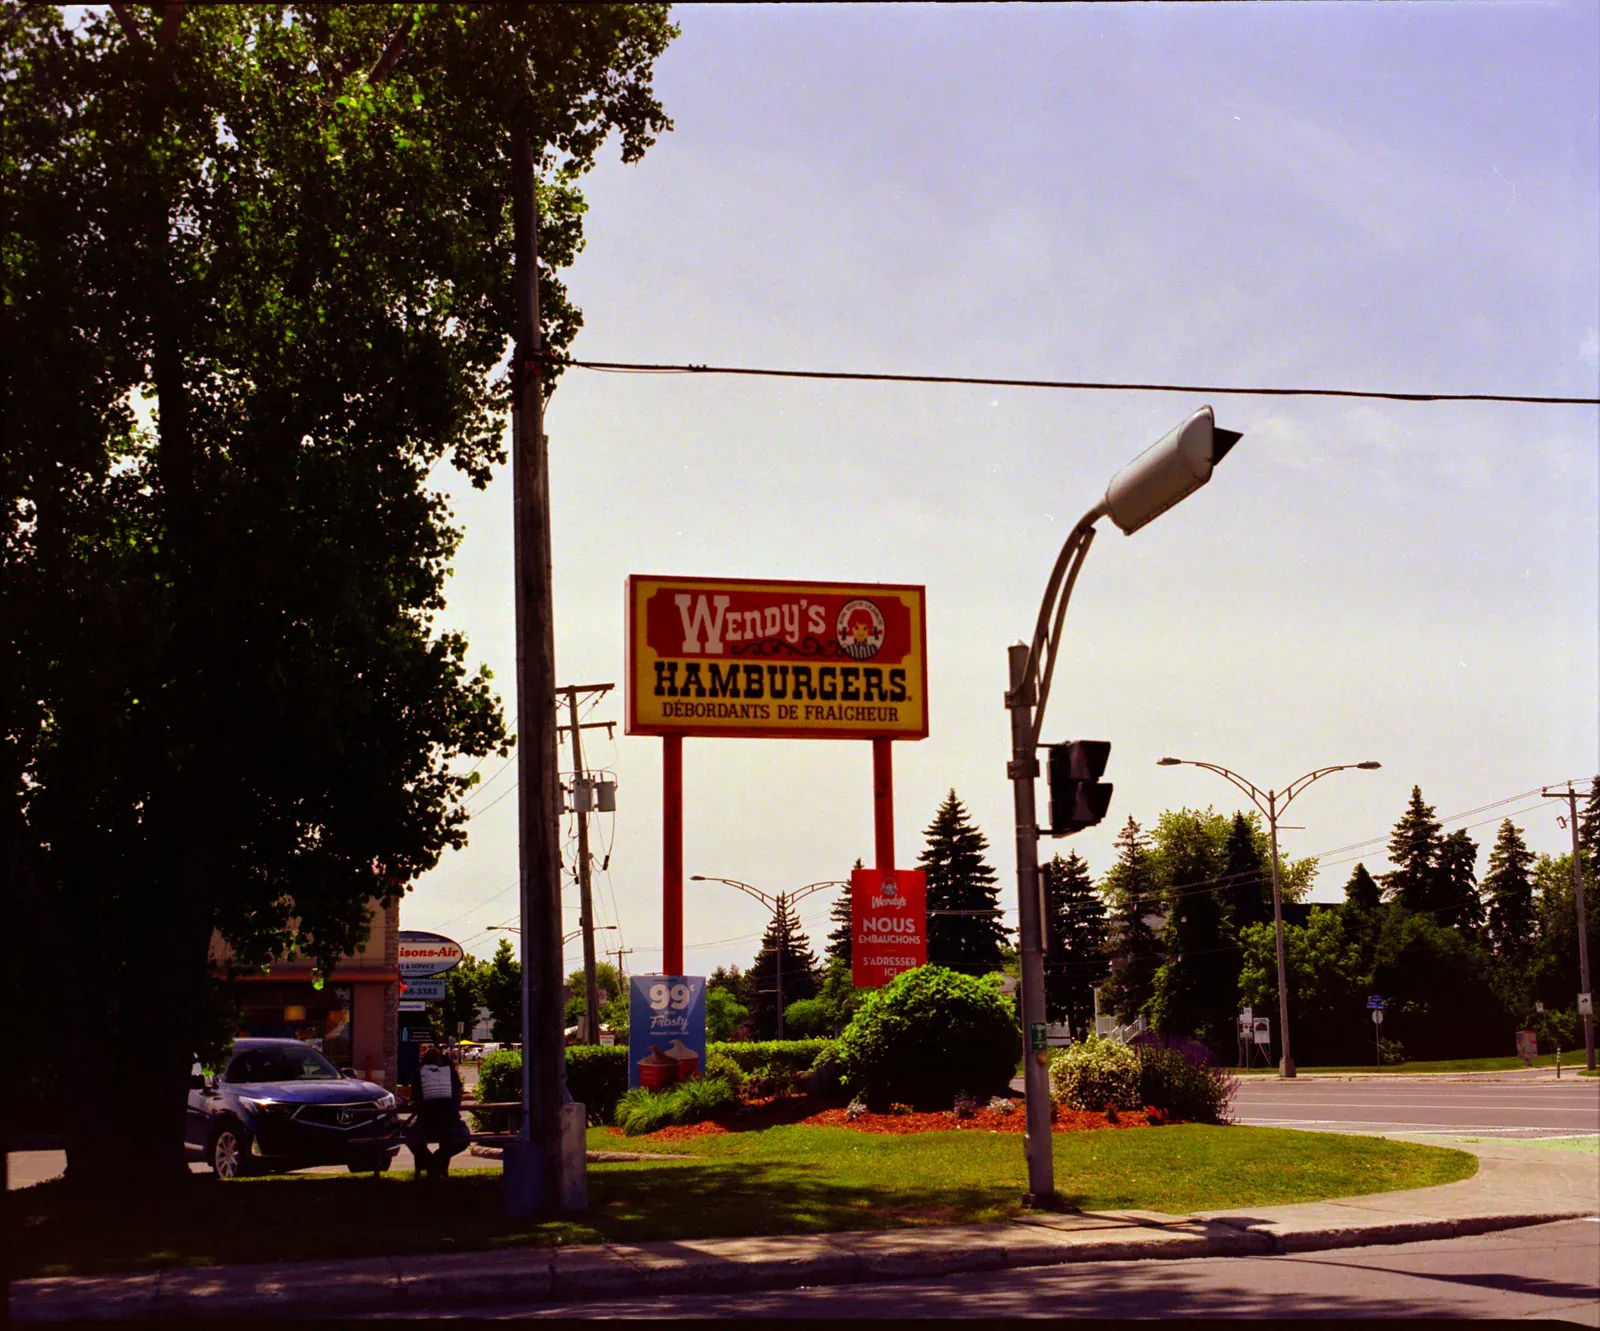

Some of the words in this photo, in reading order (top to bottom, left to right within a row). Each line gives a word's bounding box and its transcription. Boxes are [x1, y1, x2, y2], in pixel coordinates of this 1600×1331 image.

[674, 593, 826, 654] Wendy's
[654, 661, 907, 702] HAMBURGERS
[662, 700, 770, 720] DÉBORDANTS
[777, 704, 799, 721] DE
[863, 917, 915, 933] NOUS
[858, 934, 920, 945] EMBAUCHONS
[399, 946, 458, 958] isons-Air
[863, 956, 917, 966] S'ADRESSER
[884, 967, 897, 977] ICI
[649, 1015, 689, 1031] Frosty
